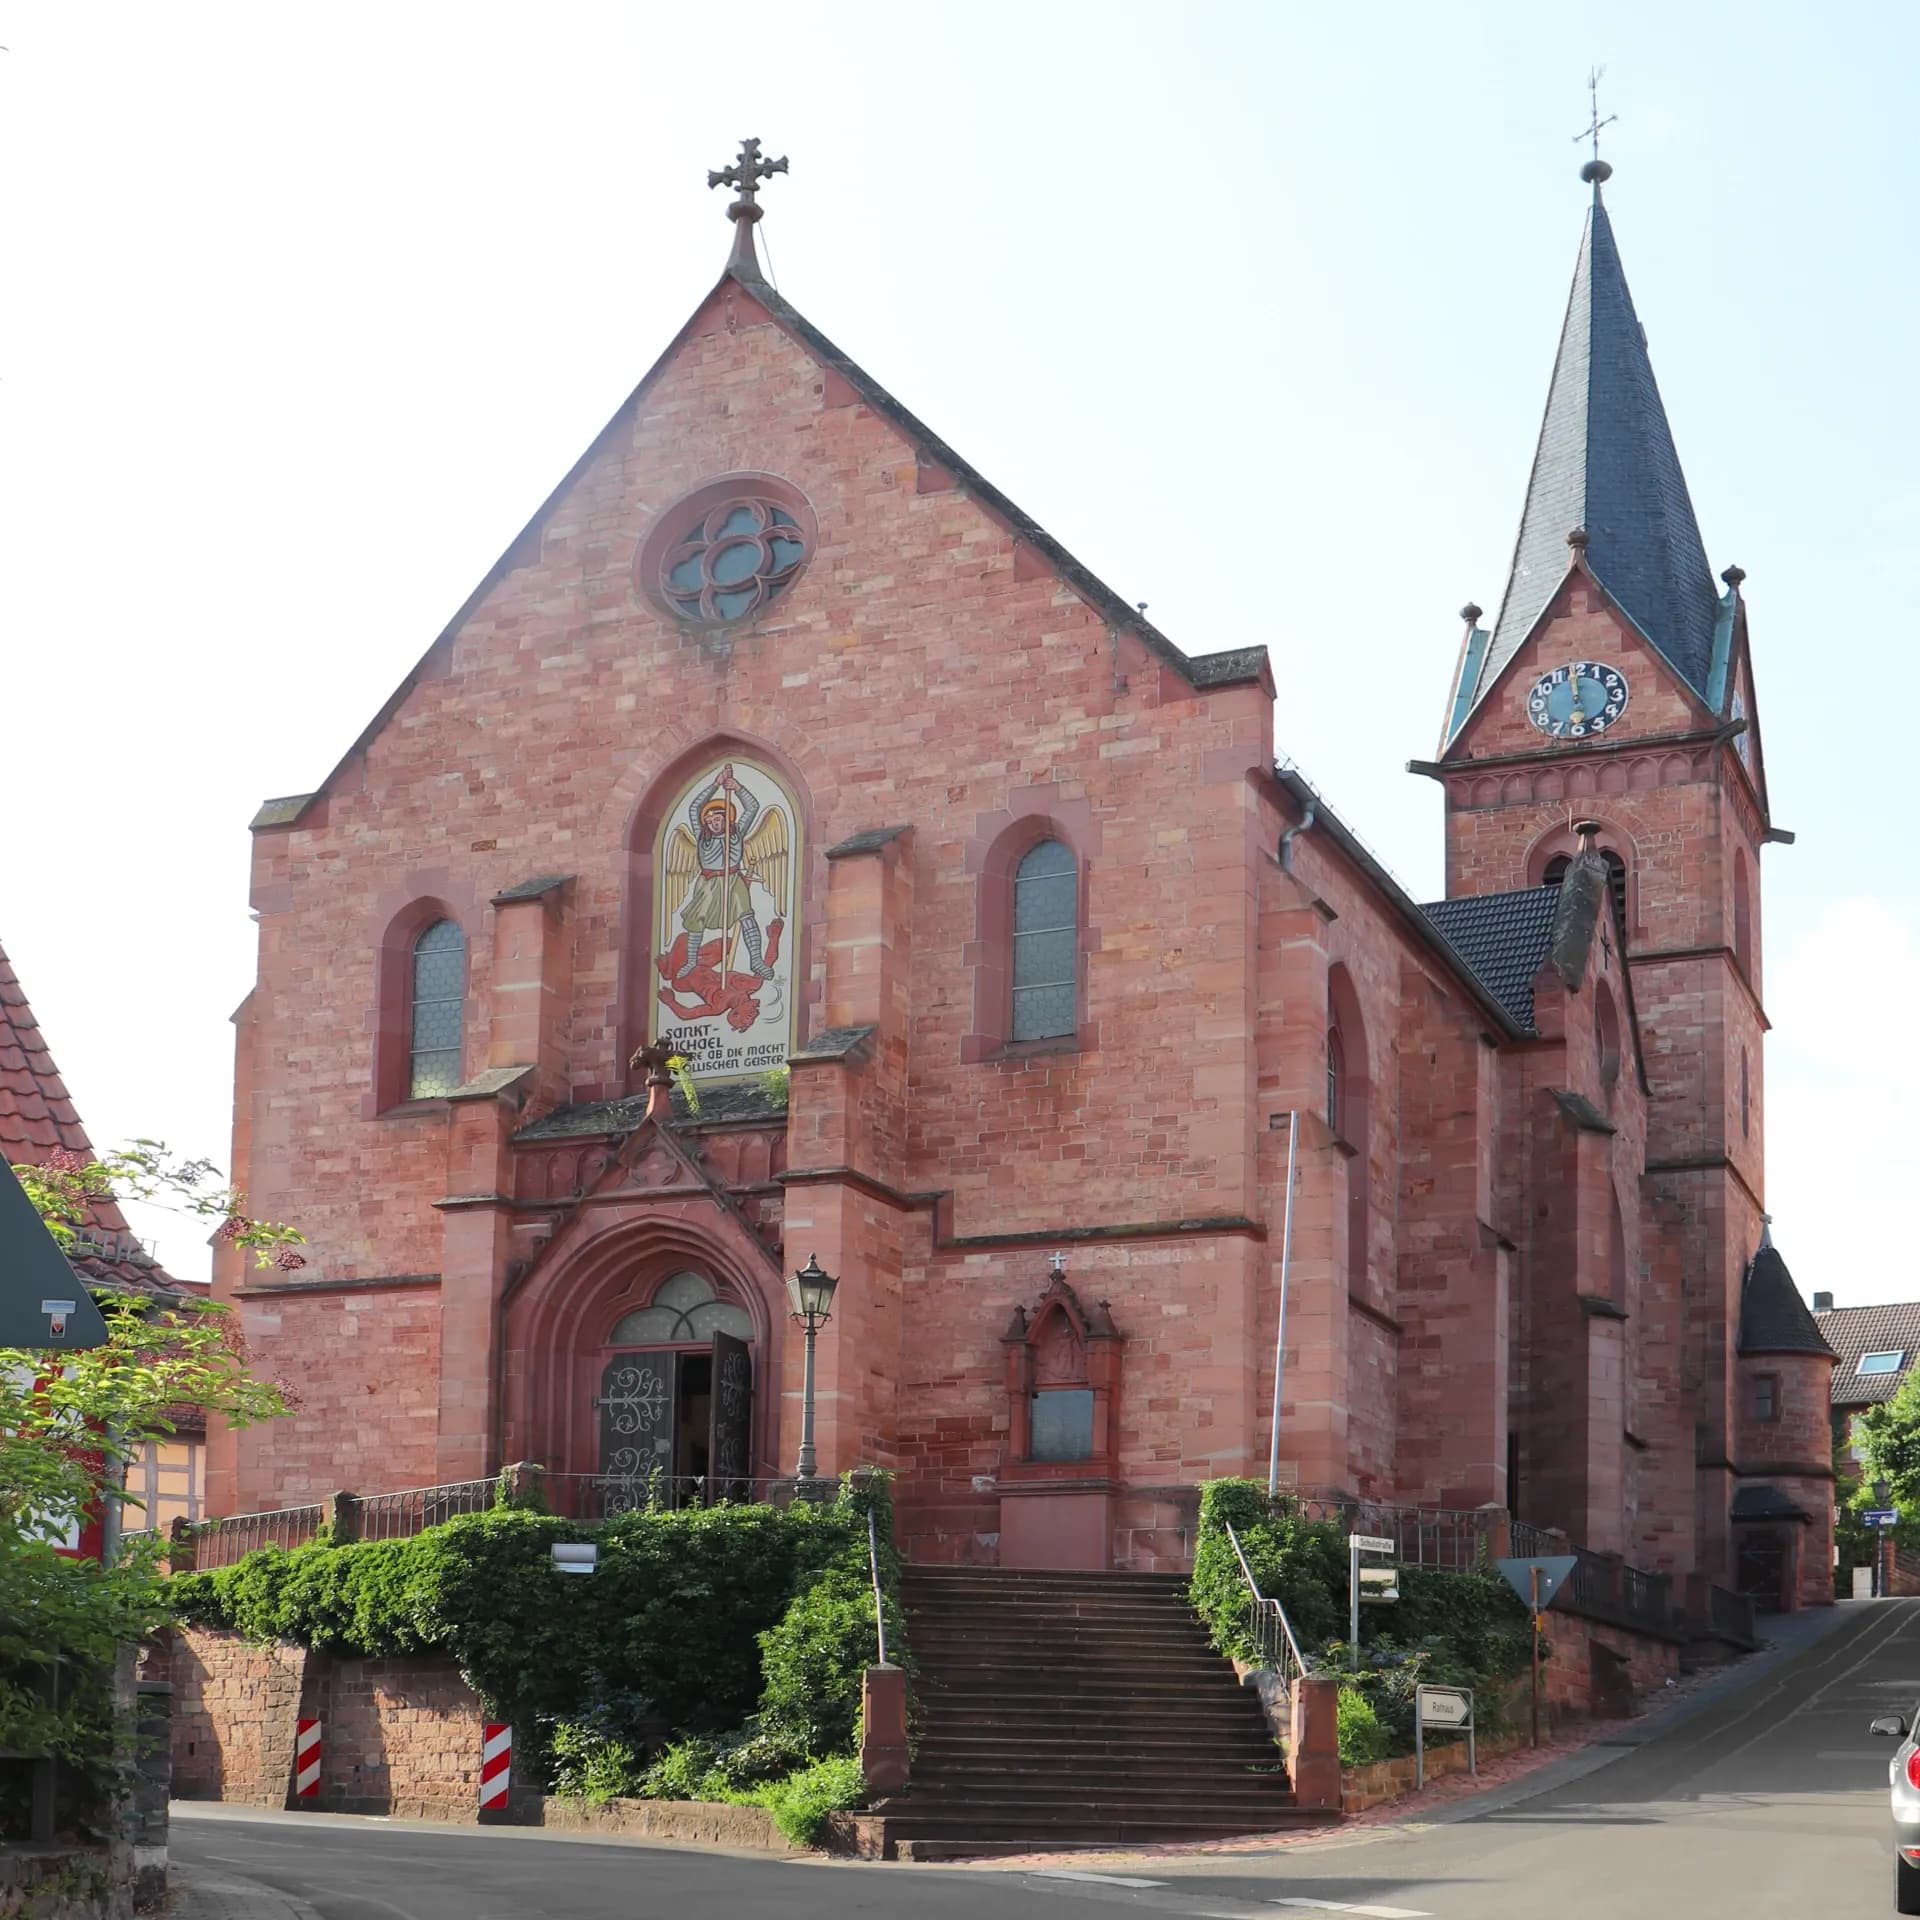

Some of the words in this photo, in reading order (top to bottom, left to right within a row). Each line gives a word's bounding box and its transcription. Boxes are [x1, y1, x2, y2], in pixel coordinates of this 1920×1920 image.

[1552, 671, 1563, 684] 11
[1591, 666, 1601, 678] 1
[1606, 674, 1618, 687] 2
[1537, 682, 1552, 696] 10
[1610, 688, 1624, 701] 3
[1531, 699, 1545, 712] 9
[1605, 704, 1618, 717] 4
[1537, 713, 1549, 726] 8
[1591, 717, 1605, 730] 5
[1552, 721, 1564, 735] 7
[1571, 722, 1585, 735] 6
[708, 1050, 723, 1060] AB
[727, 1047, 743, 1058] DIE
[747, 1043, 785, 1056] MACHT
[743, 1055, 784, 1067] GEISTER
